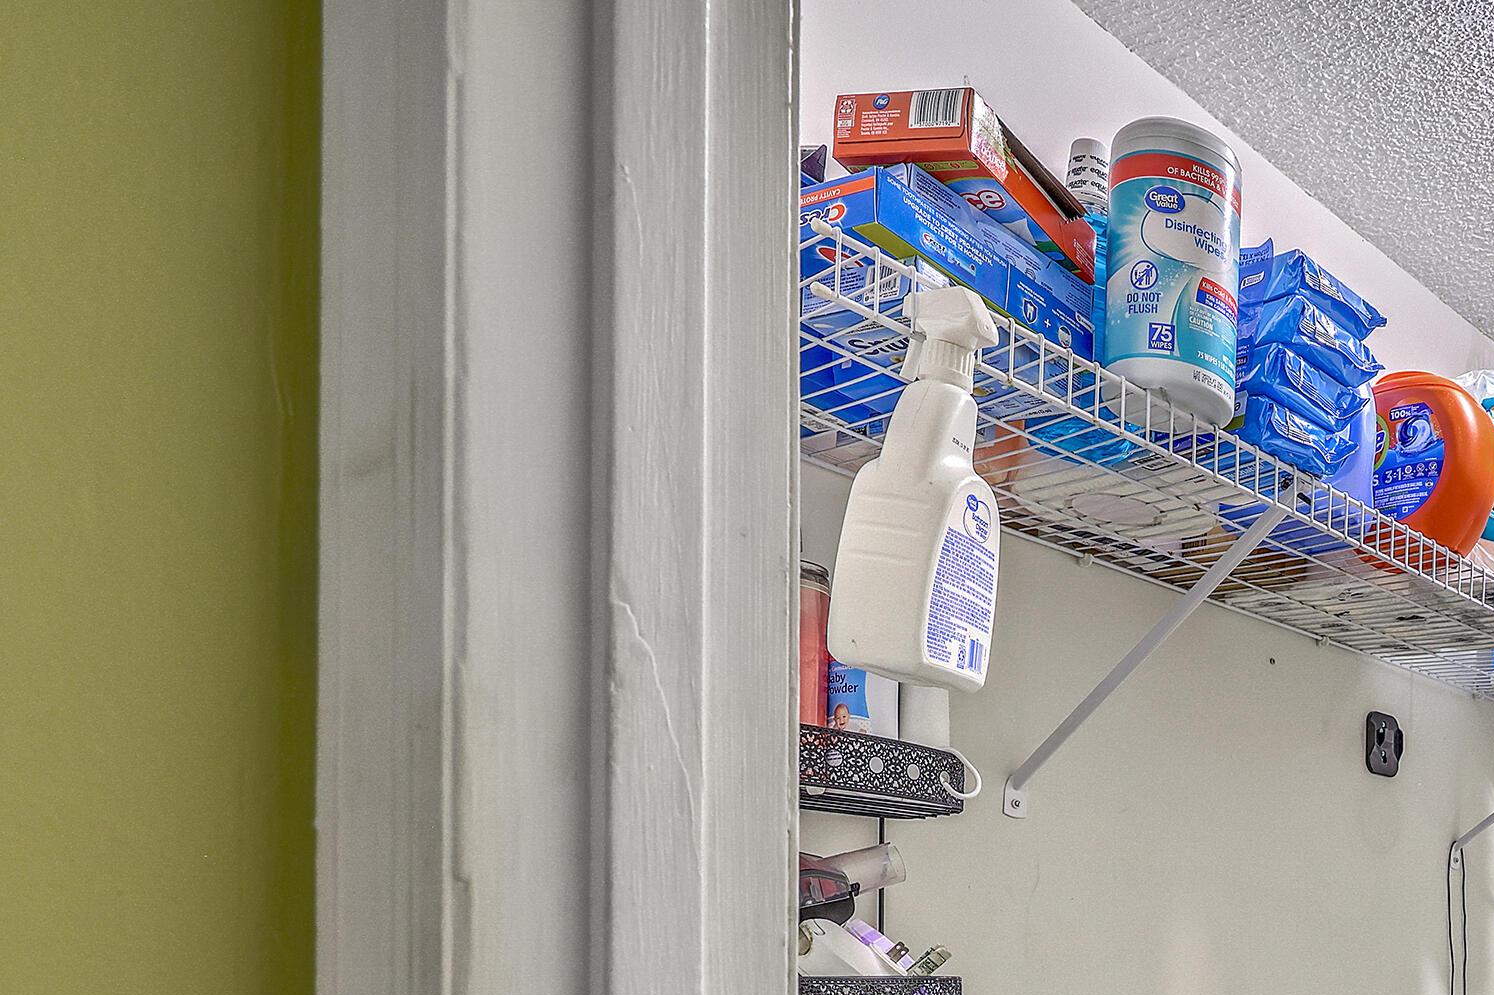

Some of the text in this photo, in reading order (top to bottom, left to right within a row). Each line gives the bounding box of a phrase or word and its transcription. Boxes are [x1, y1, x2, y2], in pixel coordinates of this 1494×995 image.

[1192, 164, 1211, 177] KILLS
[1167, 166, 1179, 175] OF
[1180, 169, 1216, 188] BACTERIA
[820, 188, 841, 199] CAVITY
[1149, 191, 1179, 204] Great
[1156, 200, 1179, 210] Value
[1164, 217, 1228, 251] Disinfecting
[1194, 236, 1227, 262] Wipes
[1127, 292, 1162, 303] DO NOT
[1128, 303, 1158, 314] FLUSH
[1189, 316, 1214, 331] CAUTION
[1151, 324, 1173, 342] 75
[1150, 341, 1173, 350] WIPES
[829, 672, 846, 684] aby
[828, 683, 859, 695] owder
